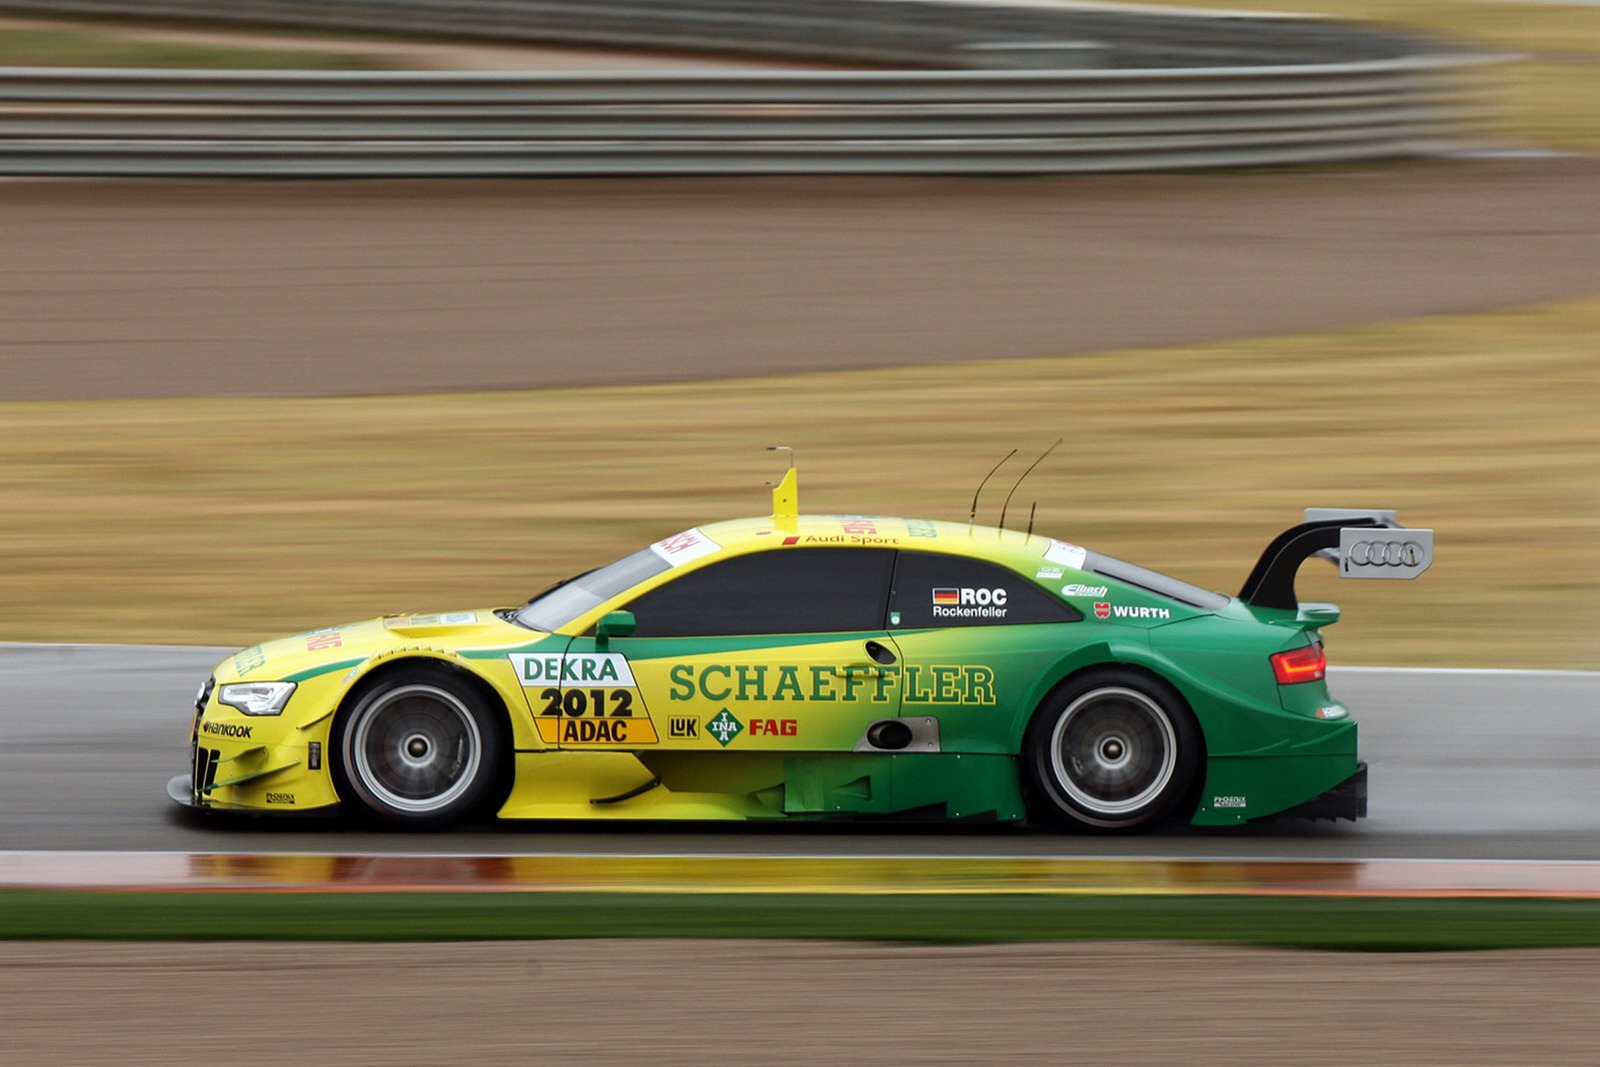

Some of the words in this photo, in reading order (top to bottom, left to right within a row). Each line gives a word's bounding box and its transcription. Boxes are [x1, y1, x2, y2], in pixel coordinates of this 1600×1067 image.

[805, 535, 845, 543] Audi
[850, 535, 900, 545] Sport
[960, 587, 1008, 606] ROC
[932, 605, 1008, 618] Rockenfeller
[523, 658, 620, 681] DEKRA
[669, 664, 997, 706] SCHAEFFLER
[540, 688, 633, 718] 2012
[563, 720, 628, 743] ADAC
[749, 719, 798, 736] FAG
